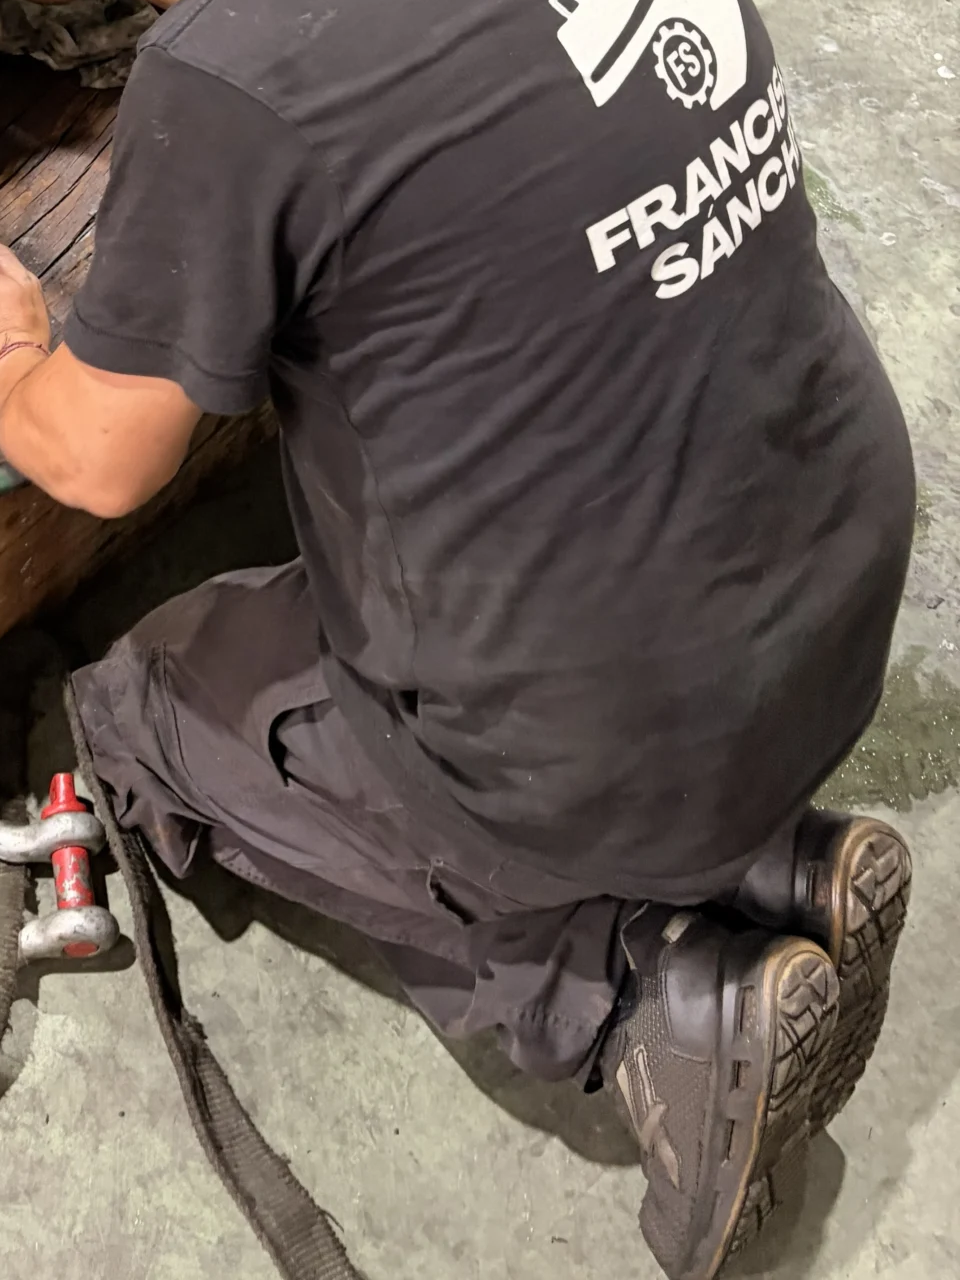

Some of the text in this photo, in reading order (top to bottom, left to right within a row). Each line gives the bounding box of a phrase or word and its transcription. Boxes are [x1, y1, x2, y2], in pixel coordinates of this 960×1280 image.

[666, 41, 701, 90] FS
[586, 61, 786, 273] FRANCIS
[650, 114, 801, 300] SÁNCH
